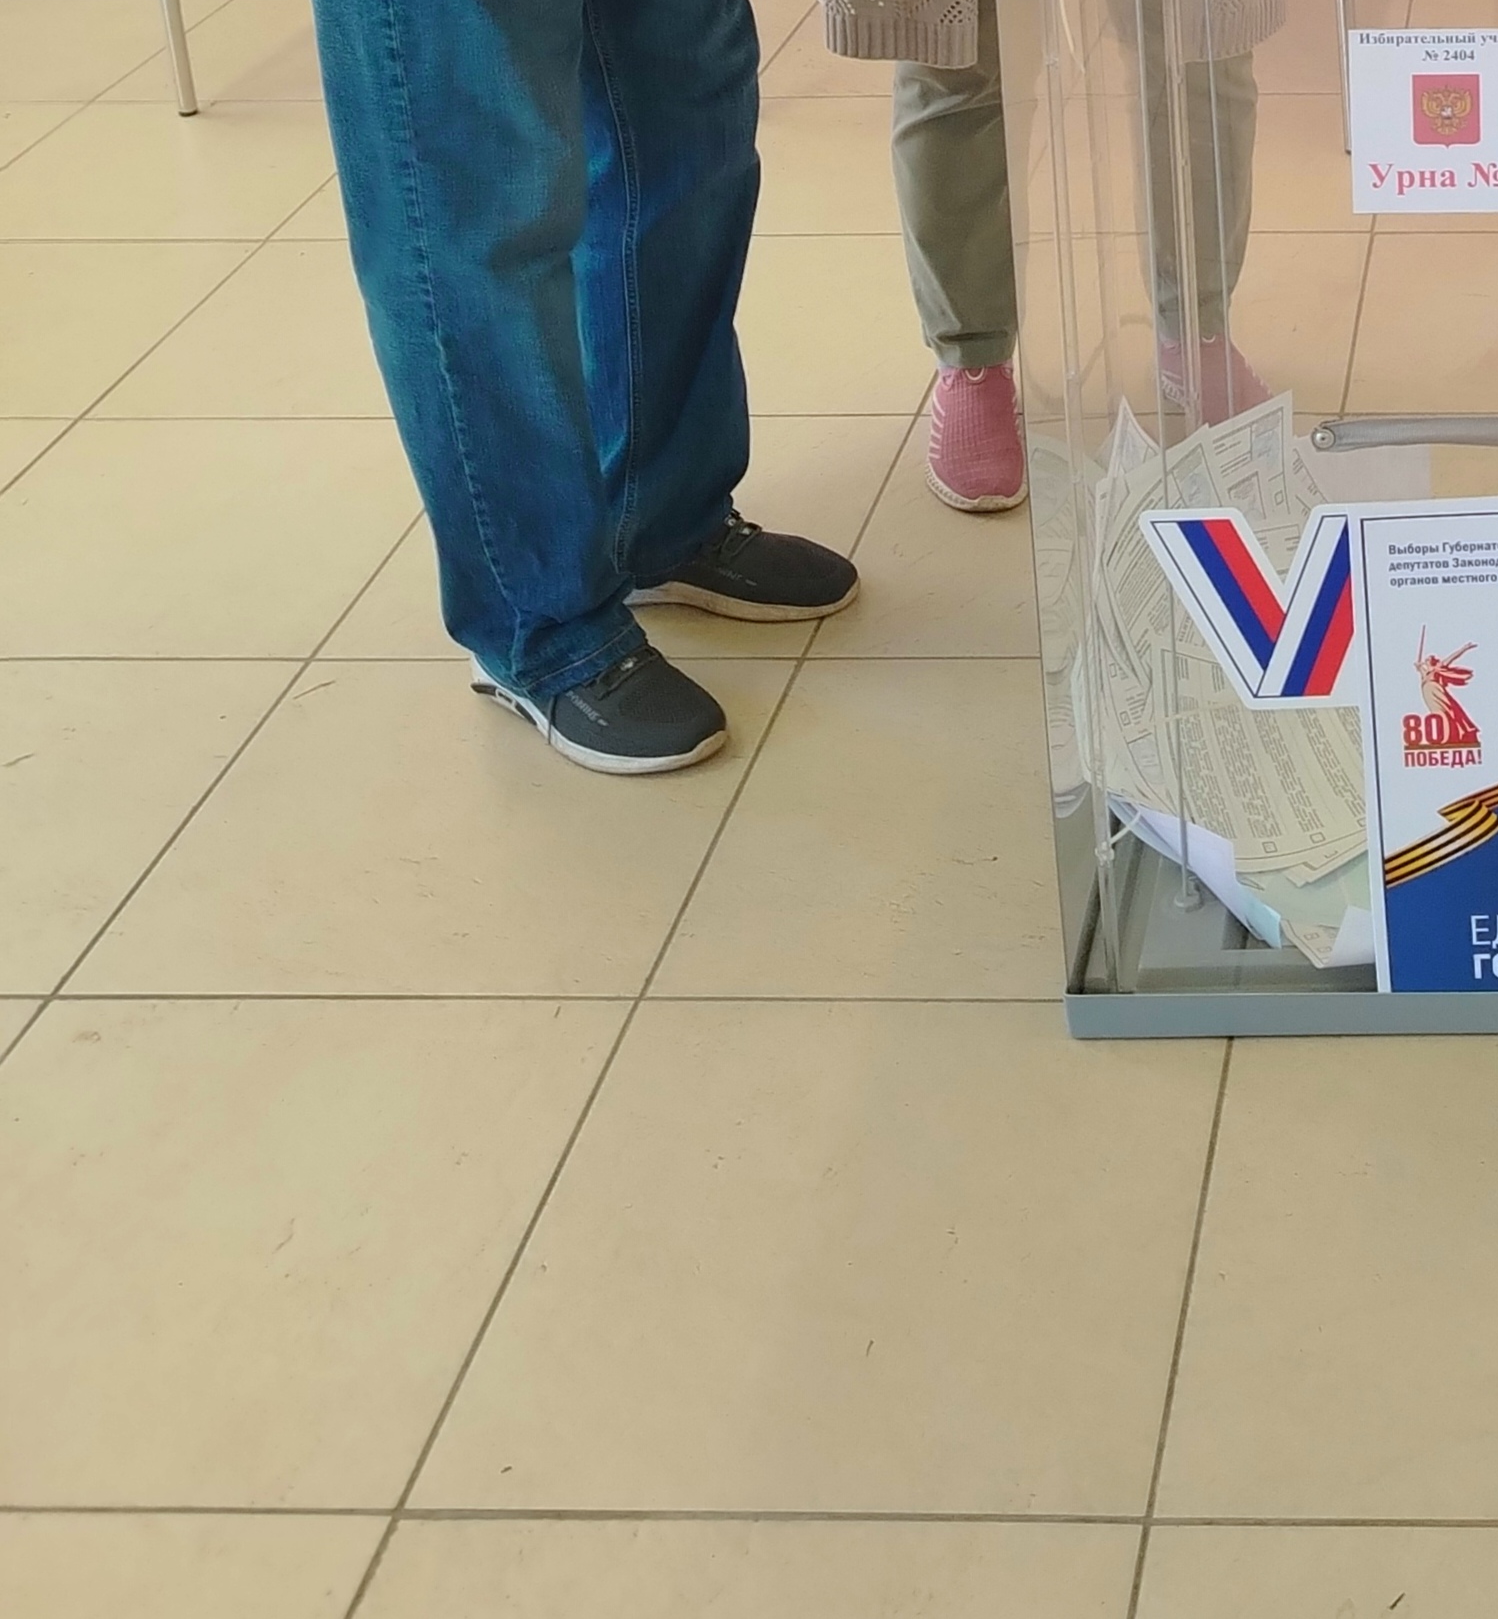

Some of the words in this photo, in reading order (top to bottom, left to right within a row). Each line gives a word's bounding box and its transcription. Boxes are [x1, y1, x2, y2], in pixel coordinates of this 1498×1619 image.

[1359, 32, 1476, 46] Избирательный
[1422, 50, 1439, 61] №
[1443, 50, 1475, 61] 2404
[1368, 163, 1457, 196] Урна
[1388, 543, 1439, 556] Выборы
[1388, 558, 1449, 572] депутатов
[1390, 574, 1438, 587] органов
[1441, 572, 1497, 584] местного
[1402, 713, 1444, 746] 80
[1404, 749, 1482, 768] ПОБЕДА!
